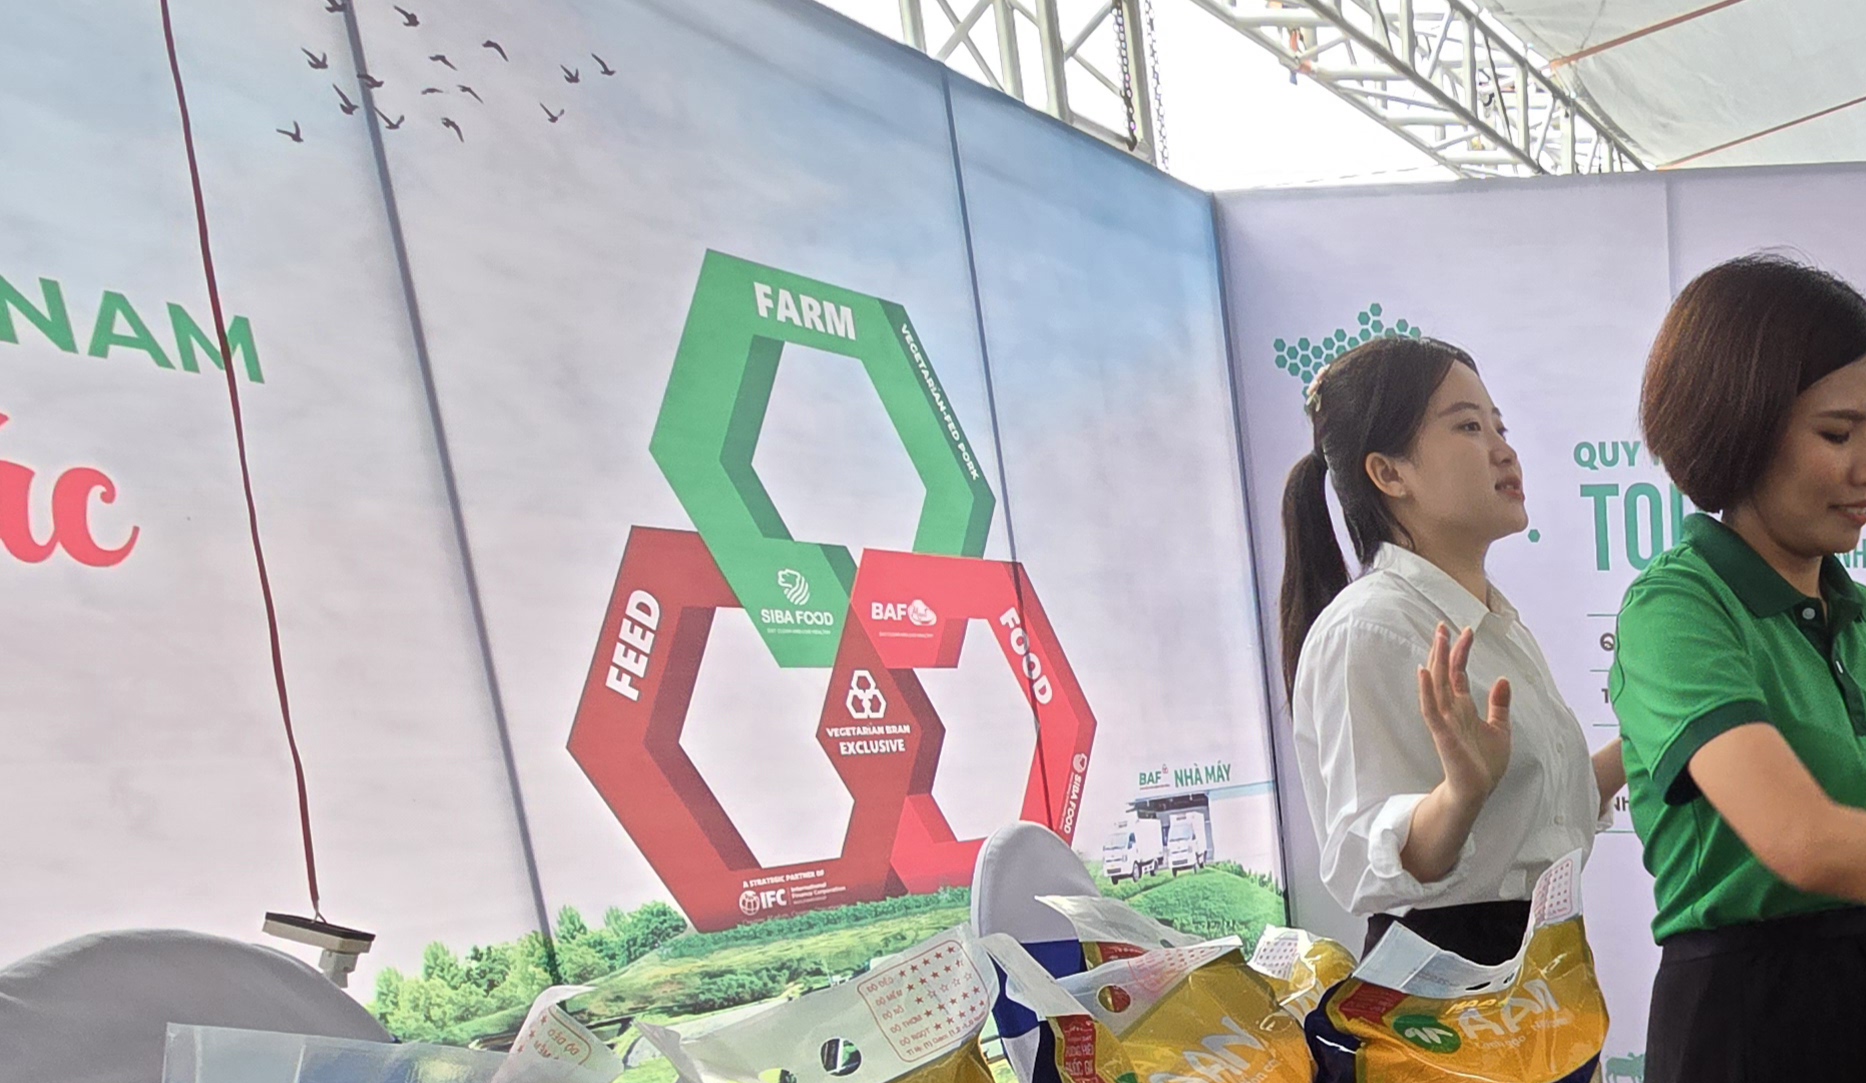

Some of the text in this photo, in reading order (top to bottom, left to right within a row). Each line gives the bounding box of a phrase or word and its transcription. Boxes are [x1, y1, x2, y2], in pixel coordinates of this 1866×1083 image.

[754, 281, 856, 341] FARM
[957, 441, 980, 481] PORK
[1573, 441, 1641, 471] QUY
[761, 608, 834, 626] SIBA FOOD
[871, 602, 907, 621] BAF
[605, 588, 660, 701] FEED
[999, 607, 1053, 705] FOOD
[839, 738, 906, 755] EXCLUSIVE
[1139, 760, 1231, 788] BAF NHÀ MÁY
[760, 889, 787, 909] IFC
